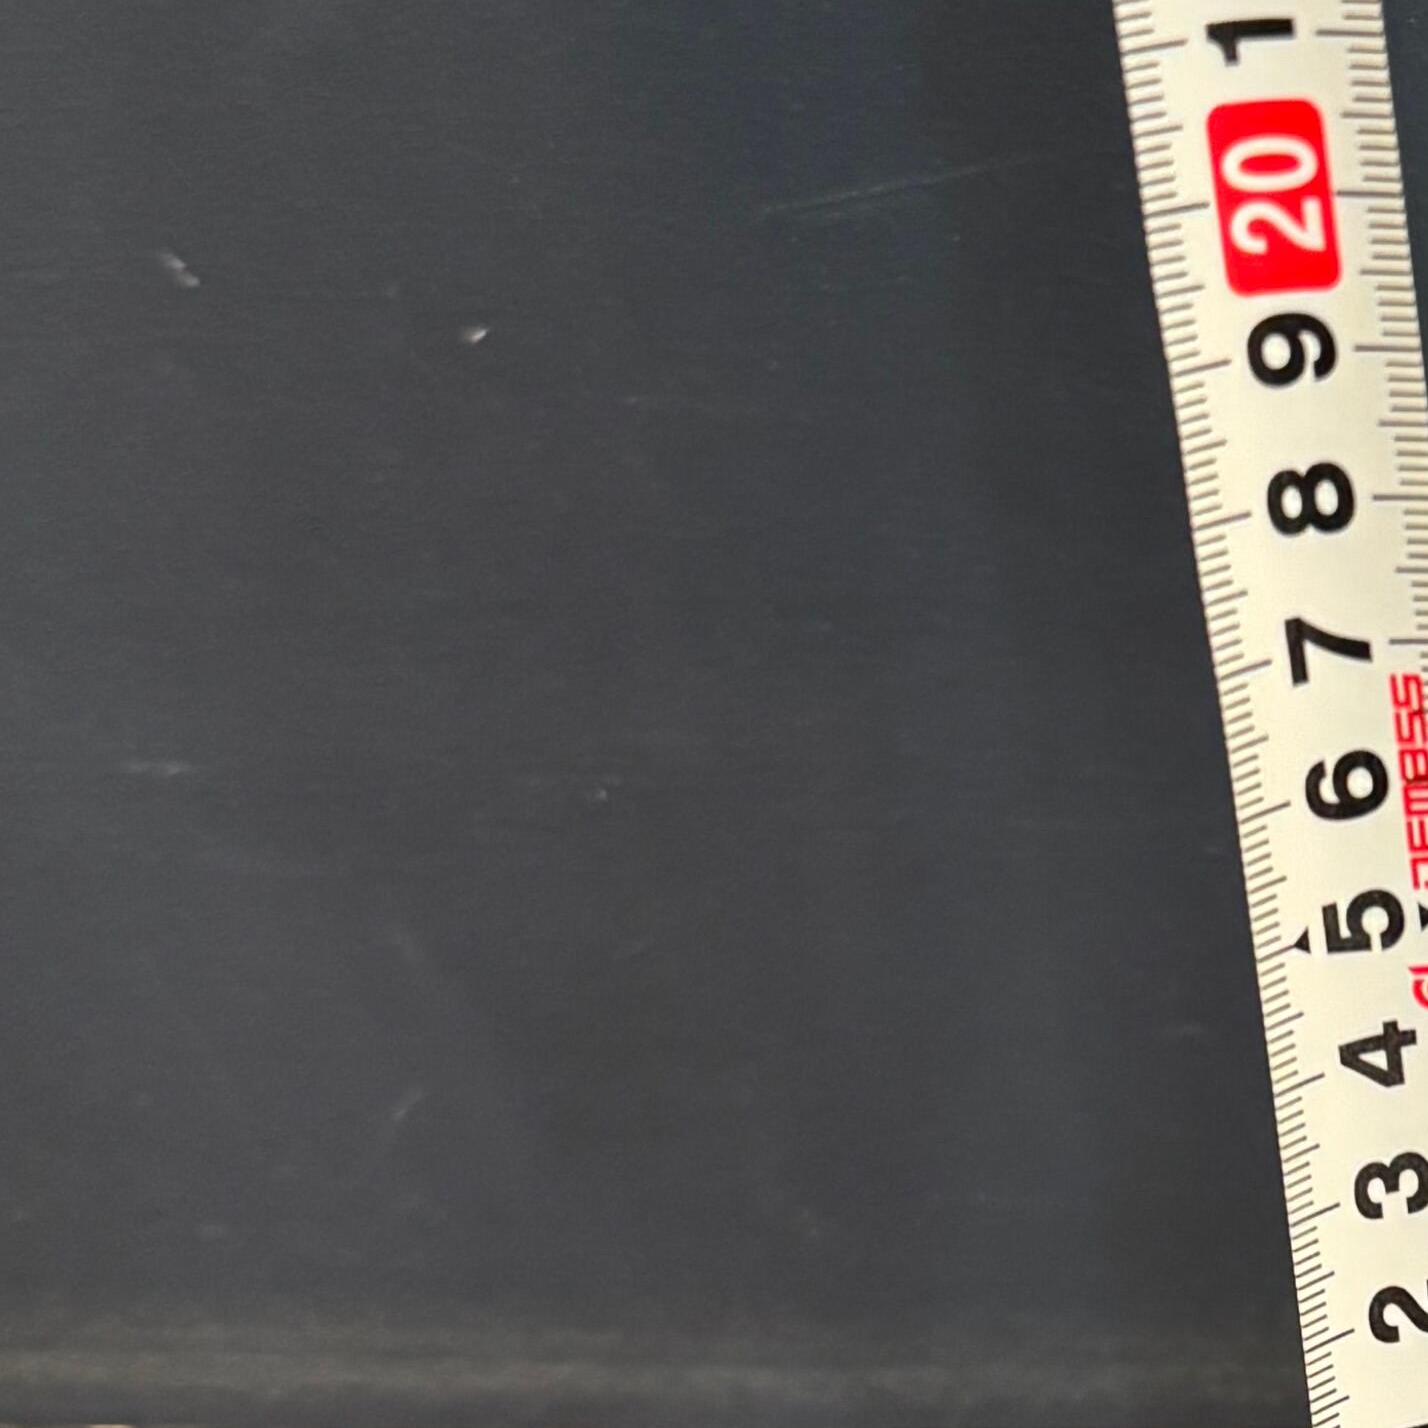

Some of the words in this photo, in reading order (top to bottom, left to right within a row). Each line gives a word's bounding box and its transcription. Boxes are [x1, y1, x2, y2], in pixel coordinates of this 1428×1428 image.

[1205, 17, 1296, 66] 1
[1221, 134, 1327, 256] 20
[1247, 311, 1339, 389] 9
[1266, 461, 1358, 536] 8
[1283, 616, 1373, 687] 7
[1304, 749, 1390, 821] 6
[1322, 888, 1405, 953] 5
[1339, 1019, 1418, 1088] 4
